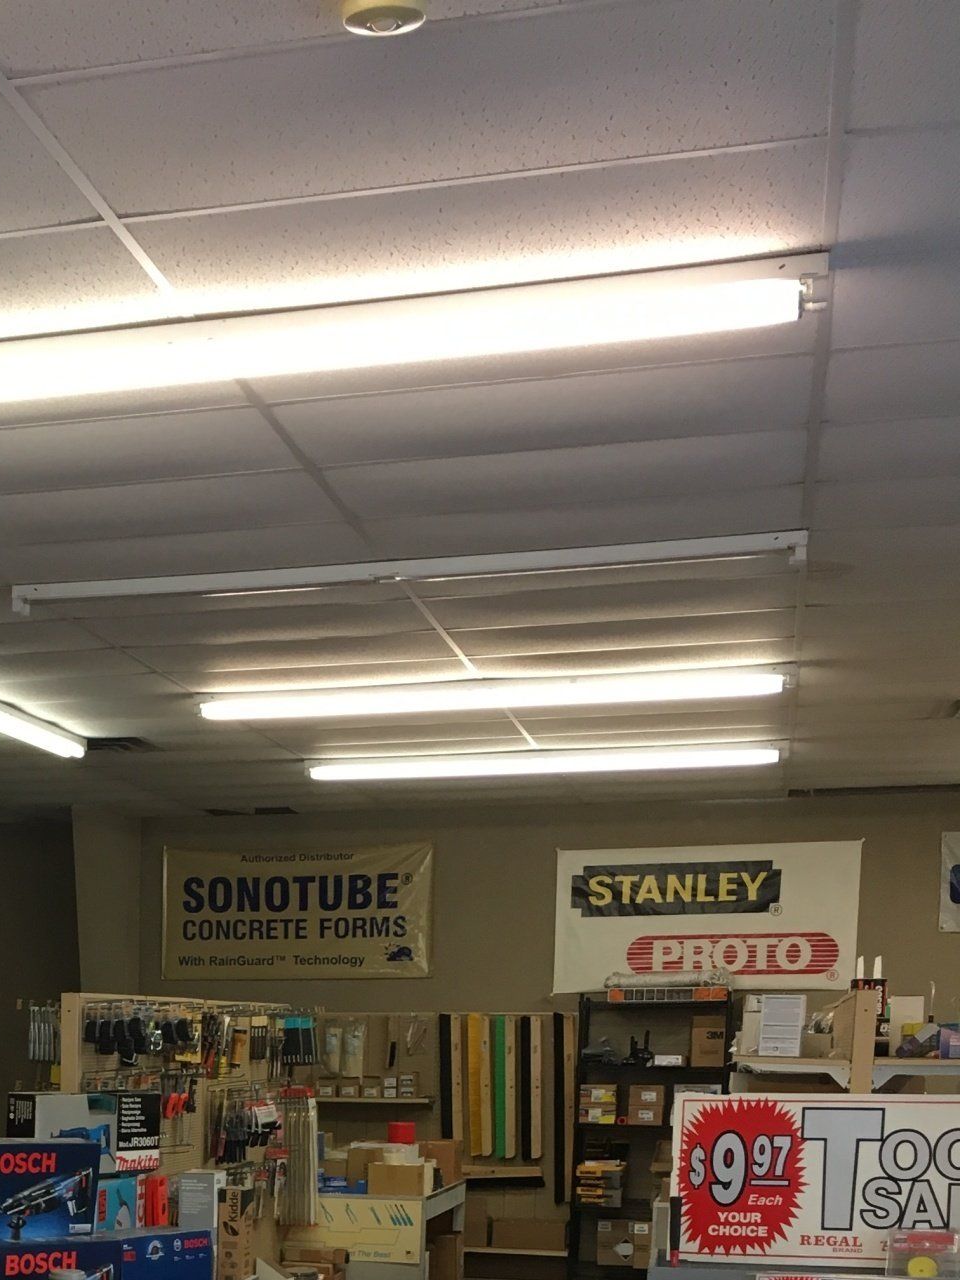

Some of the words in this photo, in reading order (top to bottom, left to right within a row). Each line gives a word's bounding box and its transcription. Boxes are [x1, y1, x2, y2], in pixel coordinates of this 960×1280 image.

[240, 854, 296, 863] Authorized
[299, 852, 355, 862] Distributor
[588, 871, 769, 907] STANLEY
[182, 918, 308, 941] CONCRETE
[319, 915, 407, 940] FORMS
[178, 955, 205, 967] With
[293, 955, 365, 967] Technology
[652, 937, 813, 973] PROTO
[706, 1031, 724, 1040] 3M
[748, 1194, 783, 1206] Each
[228, 1191, 239, 1223] Kidde
[717, 1212, 762, 1224] YOUR
[708, 1225, 768, 1237] CHOICE
[184, 1238, 208, 1249] BOSCH
[799, 1235, 862, 1247] REGAL
[5, 1251, 77, 1276] BOSCH
